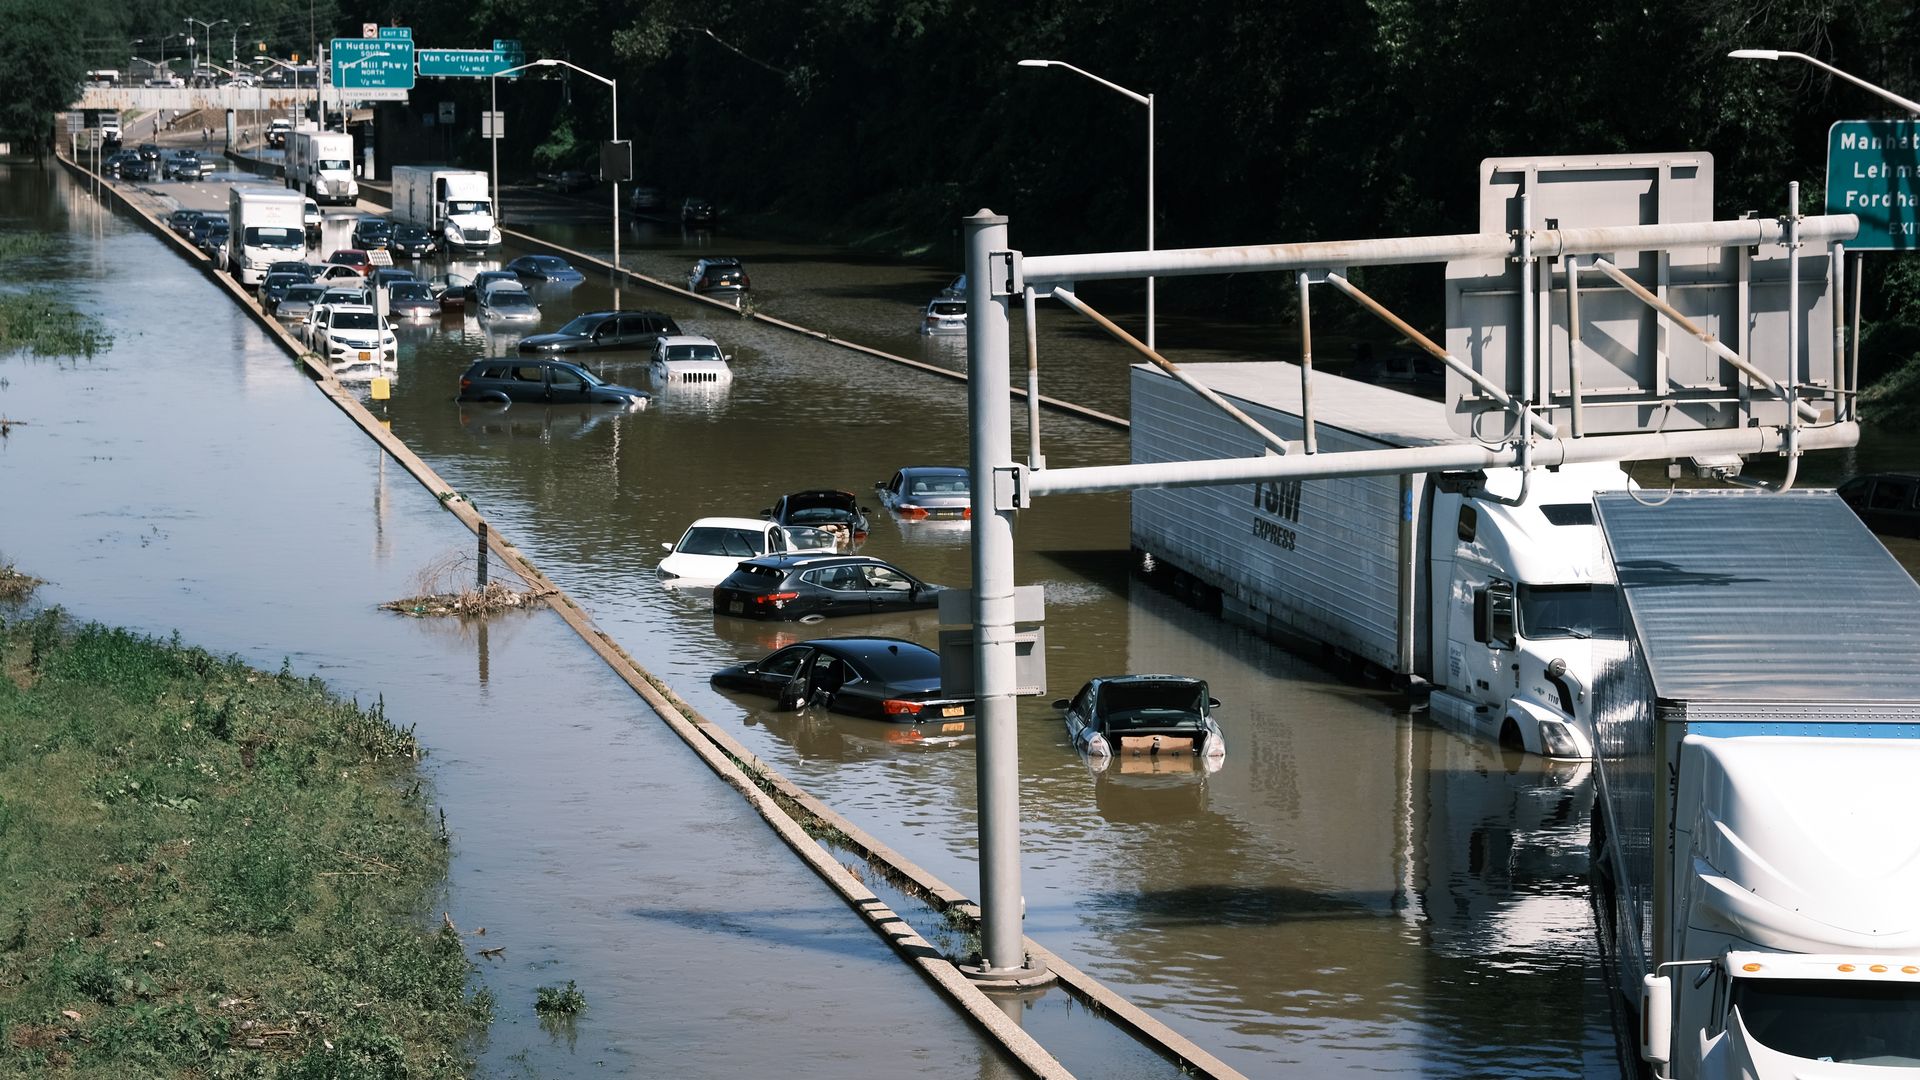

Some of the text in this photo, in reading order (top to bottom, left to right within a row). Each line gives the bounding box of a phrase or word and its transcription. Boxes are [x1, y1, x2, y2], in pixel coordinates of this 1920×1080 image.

[335, 42, 410, 52] H Hudson Pkwy
[423, 54, 440, 62] Van
[444, 54, 489, 63] Cortlandt
[382, 61, 408, 70] Pkwy
[1253, 517, 1296, 551] EXPRESS
